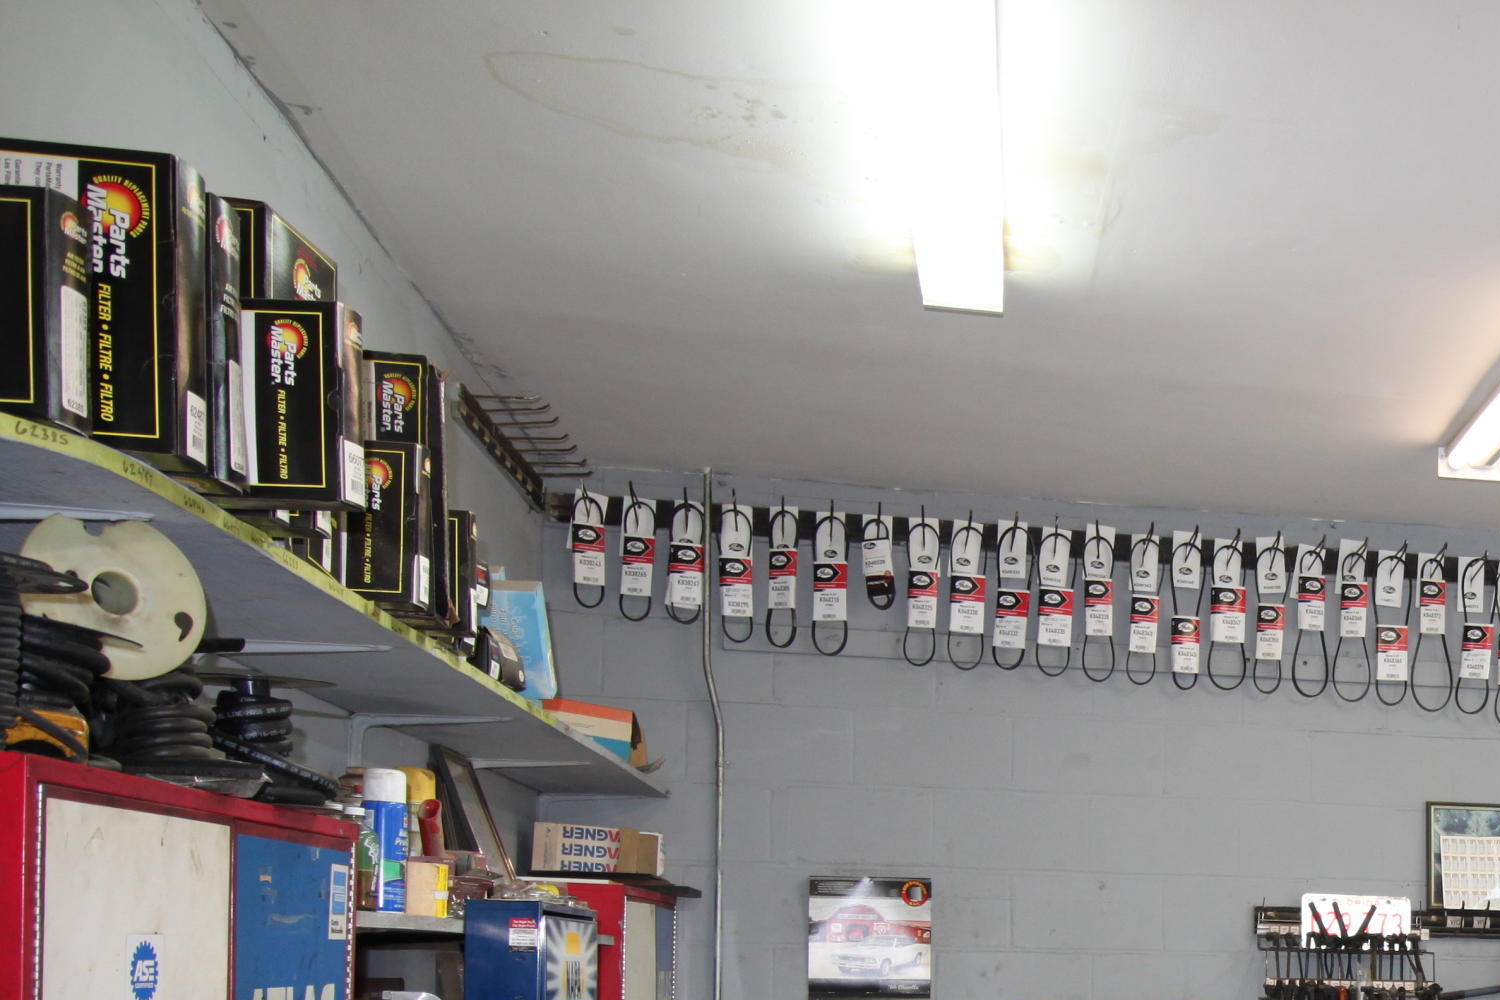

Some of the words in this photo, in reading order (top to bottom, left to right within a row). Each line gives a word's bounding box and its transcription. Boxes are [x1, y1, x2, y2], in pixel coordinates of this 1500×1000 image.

[108, 207, 132, 280] Parts
[98, 283, 112, 321] FILTER
[98, 332, 113, 372] FILTRE
[270, 325, 284, 384] Master
[283, 340, 297, 387] Parts
[99, 381, 114, 422] FILTRO
[277, 388, 286, 415] FILTER
[381, 380, 394, 431] Master
[393, 393, 405, 434] Parts
[277, 420, 287, 448] FILTRE
[278, 453, 289, 480] FILTRO
[371, 474, 383, 511] Parts
[561, 843, 619, 860] AGNER
[562, 826, 620, 843] AGNER
[560, 860, 616, 873] AGNER
[133, 959, 155, 982] ASE
